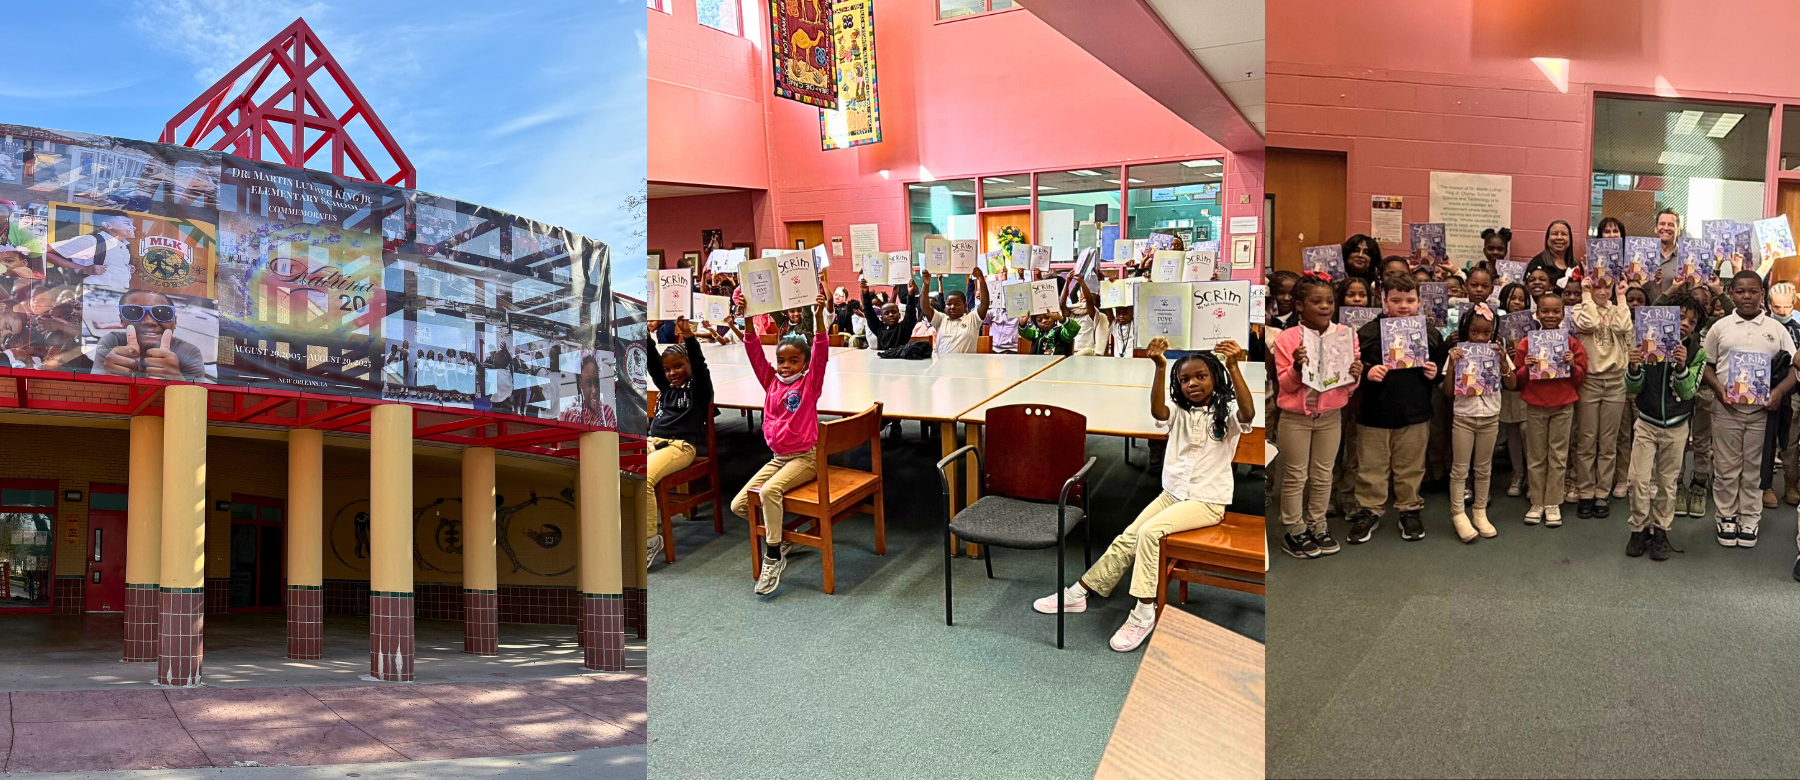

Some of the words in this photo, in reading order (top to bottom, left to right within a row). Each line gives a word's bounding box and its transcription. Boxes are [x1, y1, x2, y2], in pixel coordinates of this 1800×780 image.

[232, 167, 251, 179] DR.
[253, 170, 293, 187] MARTIN
[295, 179, 333, 198] LUTHER
[335, 189, 360, 202] KING
[360, 193, 374, 205] JR.
[250, 185, 319, 205] ELEMENTARY
[321, 197, 362, 211] SCHOOL
[268, 204, 338, 222] COMMEMORATES
[149, 237, 183, 251] MLK
[279, 265, 375, 295] Katrina
[339, 294, 366, 313] 20
[232, 344, 269, 356] AUGUST
[307, 353, 342, 364] AUGUST
[355, 359, 372, 368] 2025
[278, 377, 292, 385] NEW
